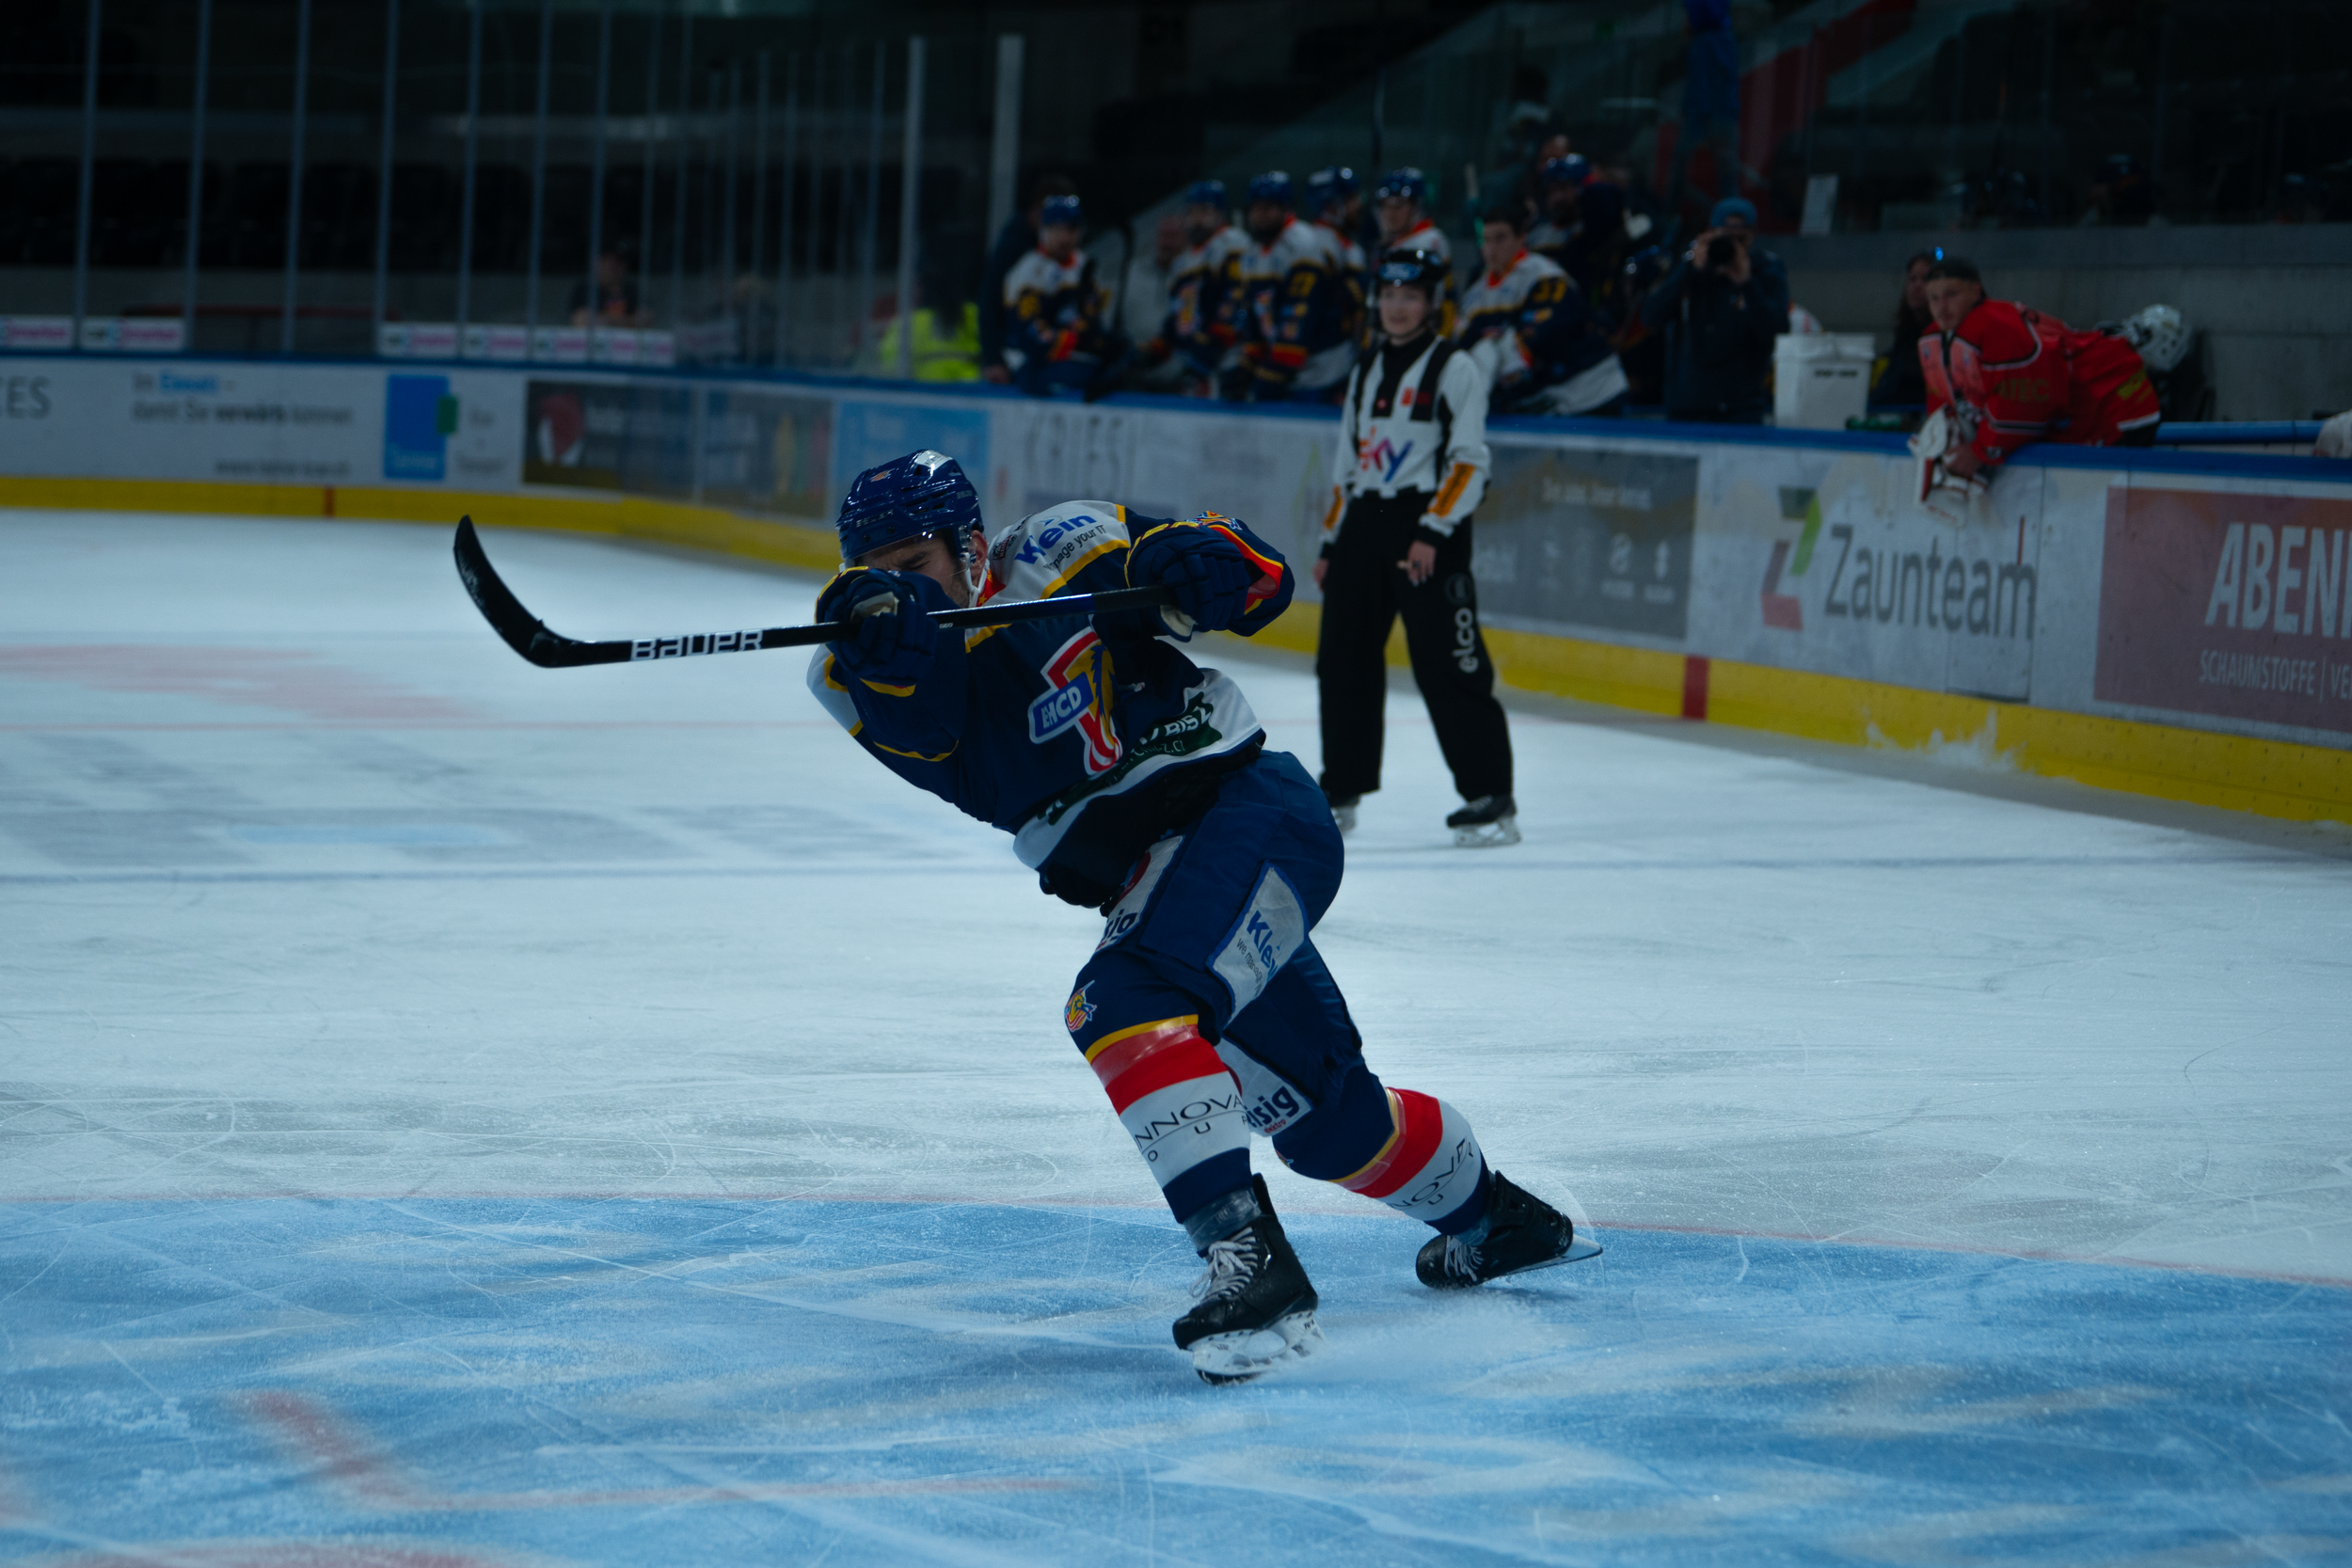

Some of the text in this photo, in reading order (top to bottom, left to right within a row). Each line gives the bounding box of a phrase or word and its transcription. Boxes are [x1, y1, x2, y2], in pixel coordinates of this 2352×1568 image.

[1073, 529, 1097, 548] your
[1826, 525, 2038, 641] Zaunteam
[628, 628, 765, 662] BAUER
[1451, 607, 1480, 674] elco
[2199, 649, 2316, 695] SCHAUMSTOFFE
